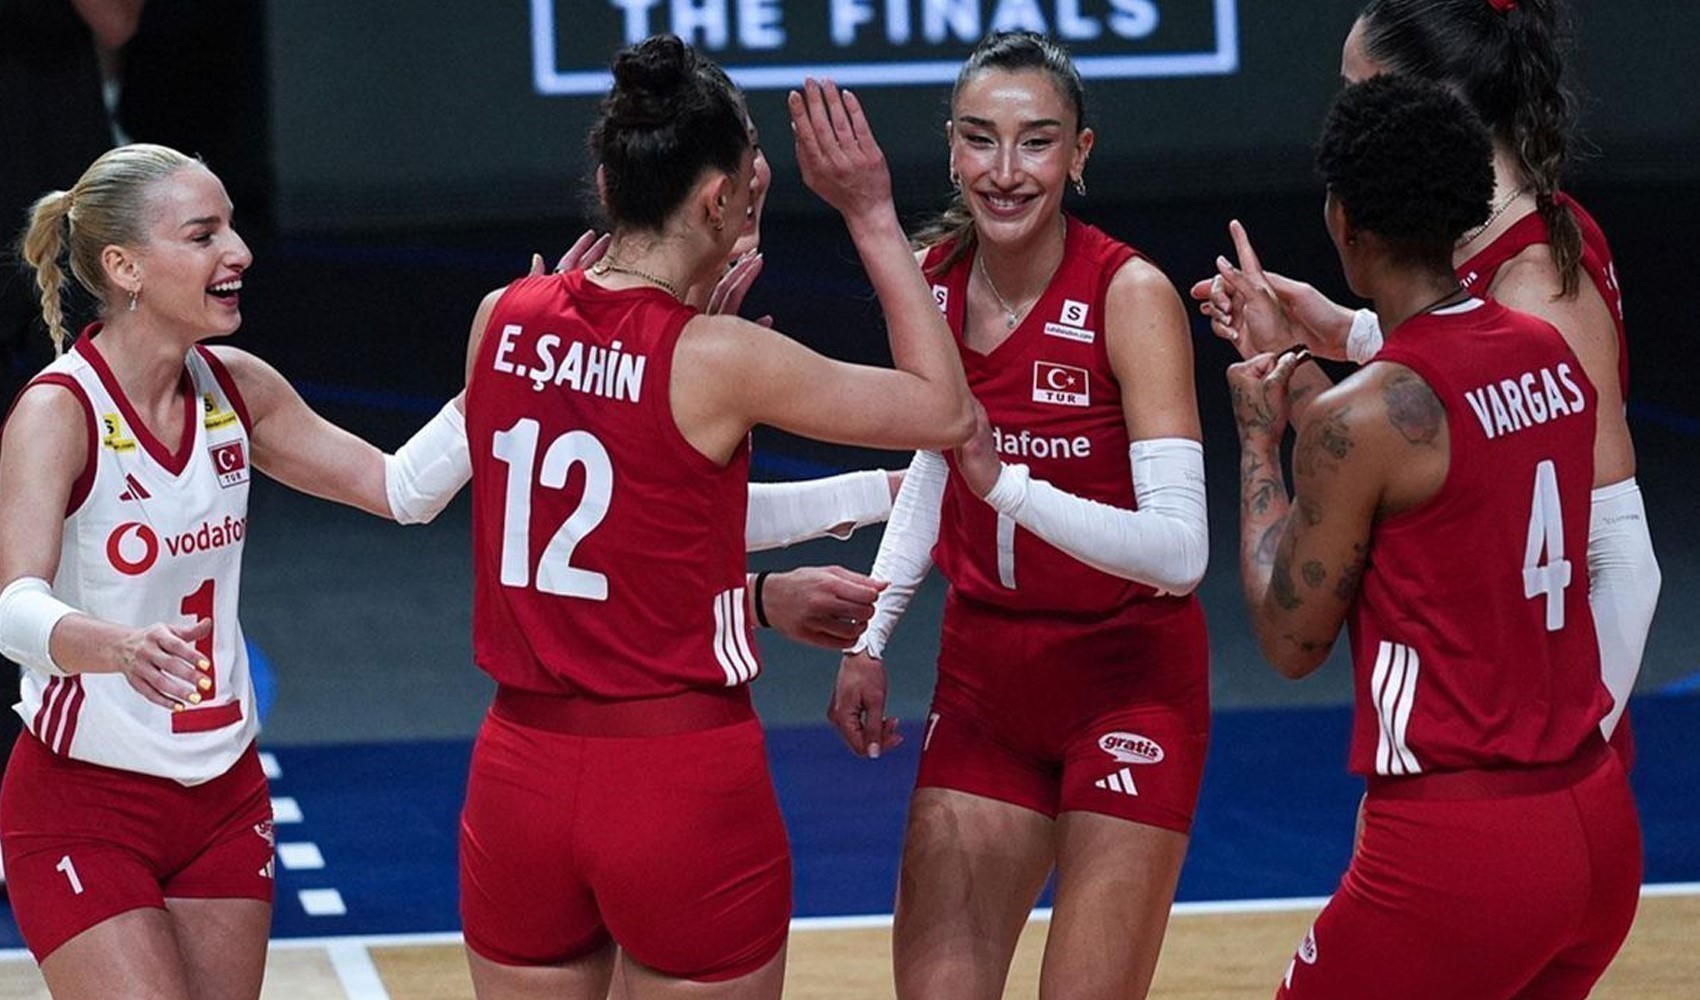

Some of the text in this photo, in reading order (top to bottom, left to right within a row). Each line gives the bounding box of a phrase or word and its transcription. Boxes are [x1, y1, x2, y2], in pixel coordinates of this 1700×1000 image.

[610, 0, 1160, 49] THE FINALS
[936, 290, 945, 305] S
[1067, 306, 1082, 321] S
[493, 324, 646, 403] E.ŞAHİN
[1046, 392, 1077, 403] TUR
[1464, 363, 1586, 439] VARGAS
[492, 417, 614, 601] 12
[1522, 459, 1572, 631] 4
[1104, 736, 1159, 757] gratis
[55, 854, 84, 895] 1
